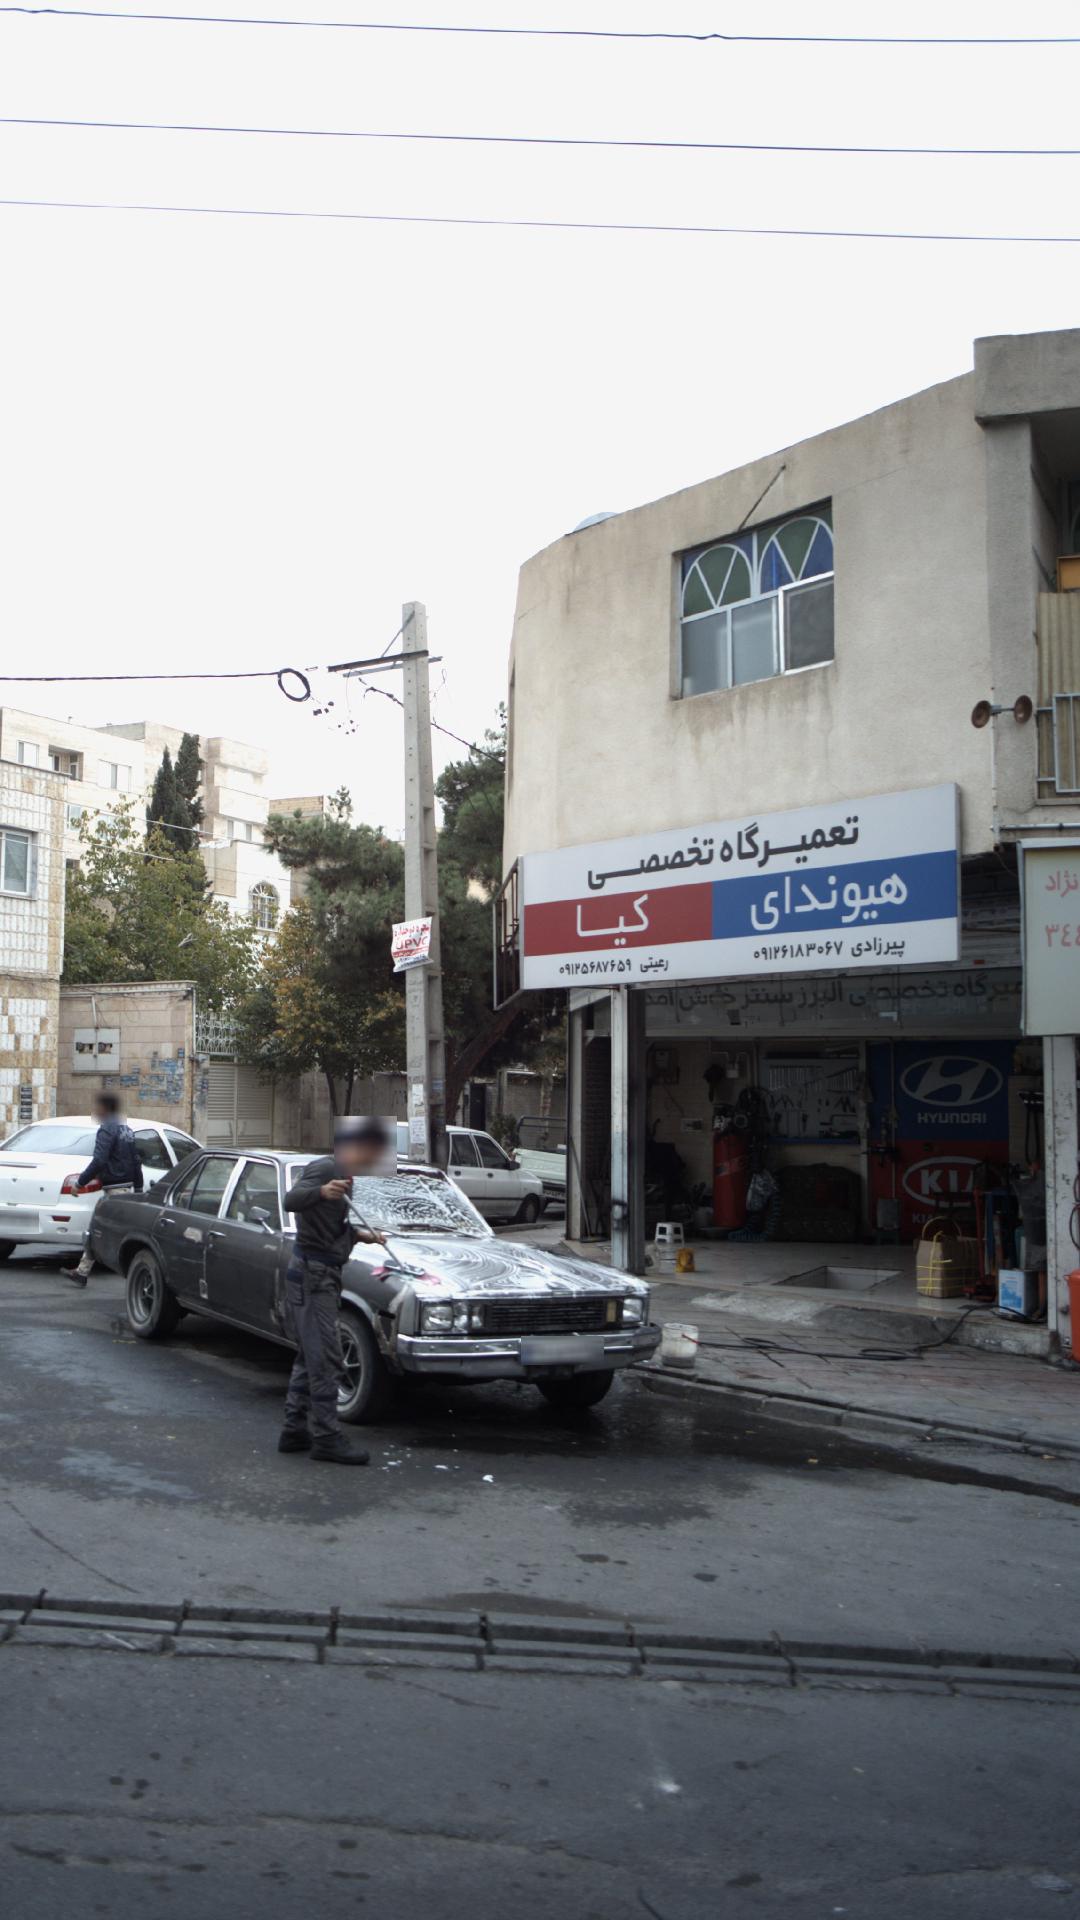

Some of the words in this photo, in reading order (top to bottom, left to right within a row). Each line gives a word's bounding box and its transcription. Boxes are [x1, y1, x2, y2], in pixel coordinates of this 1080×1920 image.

[720, 815, 859, 868] تعمیرگاه
[588, 837, 714, 890] تخصصی
[751, 873, 907, 931] هیوندای
[576, 894, 649, 945] کیا
[754, 940, 843, 960] ۰۹۱۲۶۱۸۳۰۶۷
[851, 937, 906, 958] پیرزادی
[640, 956, 669, 973] رعیتی
[798, 980, 843, 1008] البرز
[917, 1111, 987, 1125] HYUNDAI
